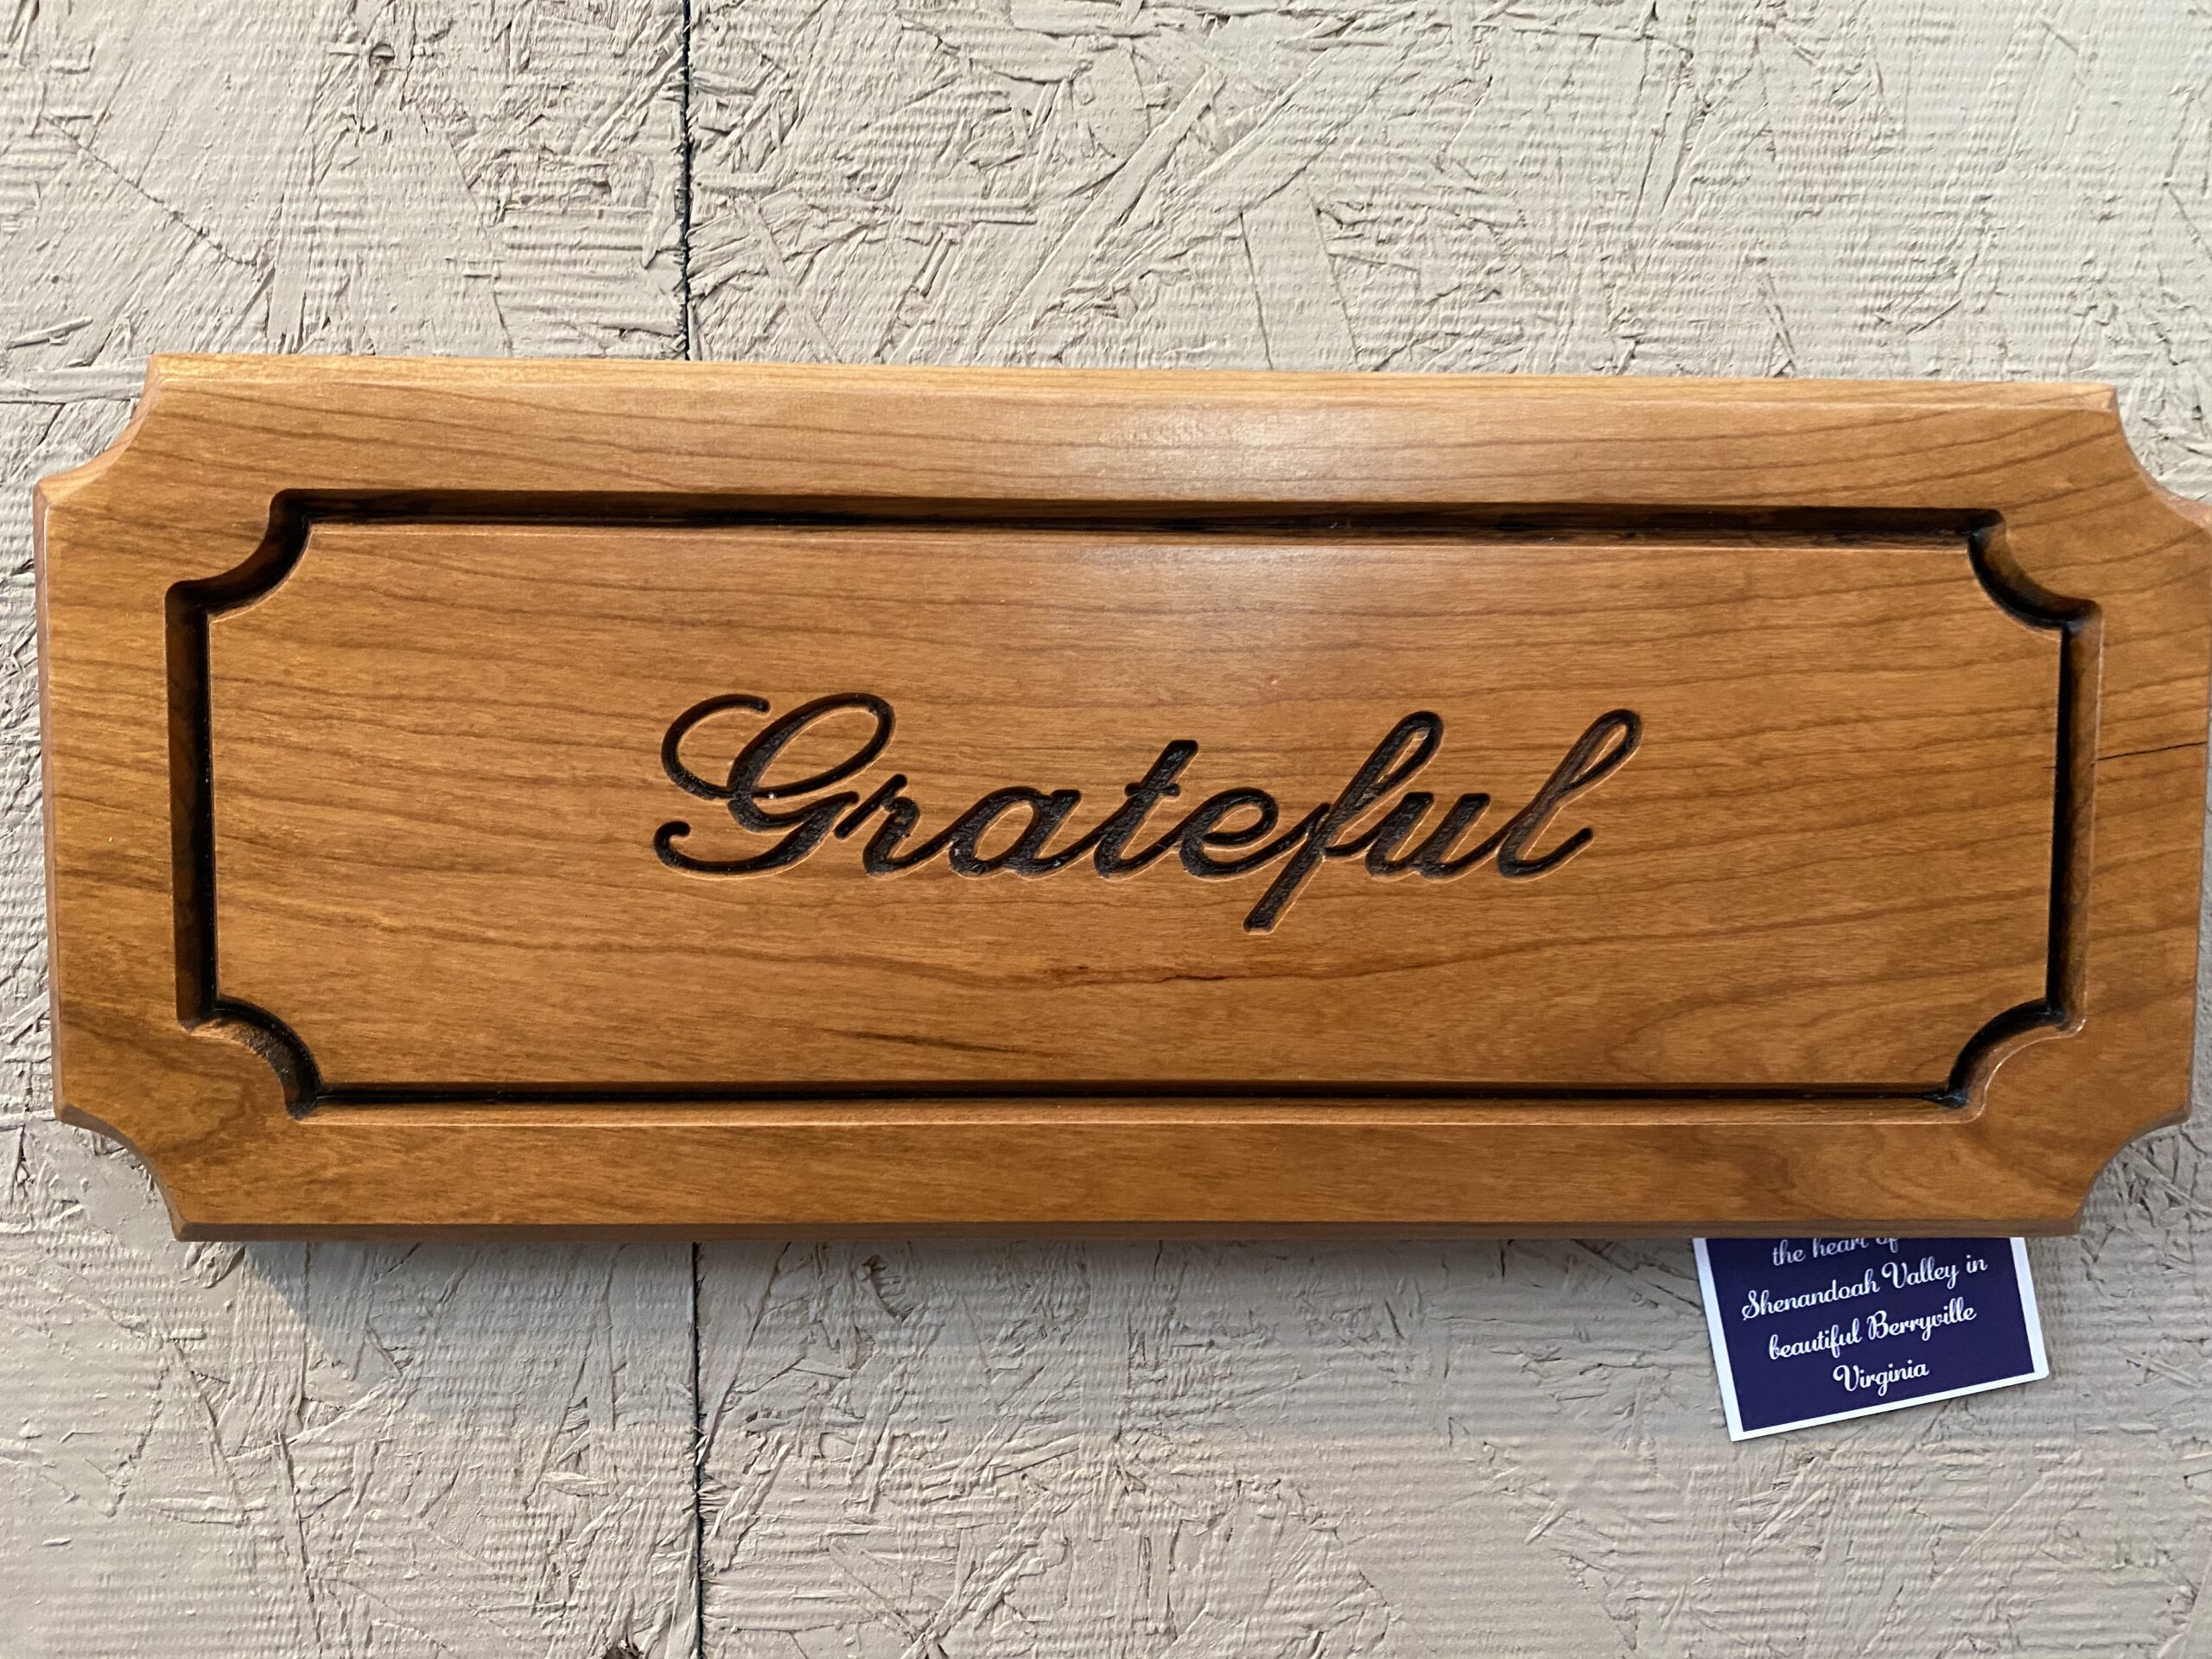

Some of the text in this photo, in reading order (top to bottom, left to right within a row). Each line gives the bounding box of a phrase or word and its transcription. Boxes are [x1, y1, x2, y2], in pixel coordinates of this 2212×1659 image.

[652, 692, 1642, 933] Grateful
[1771, 1239, 1806, 1266] the
[1742, 1254, 1988, 1320] Shenandoah Valley in
[1769, 1297, 1977, 1360] beautiful Berryville
[1833, 1360, 1929, 1396] Virginia
